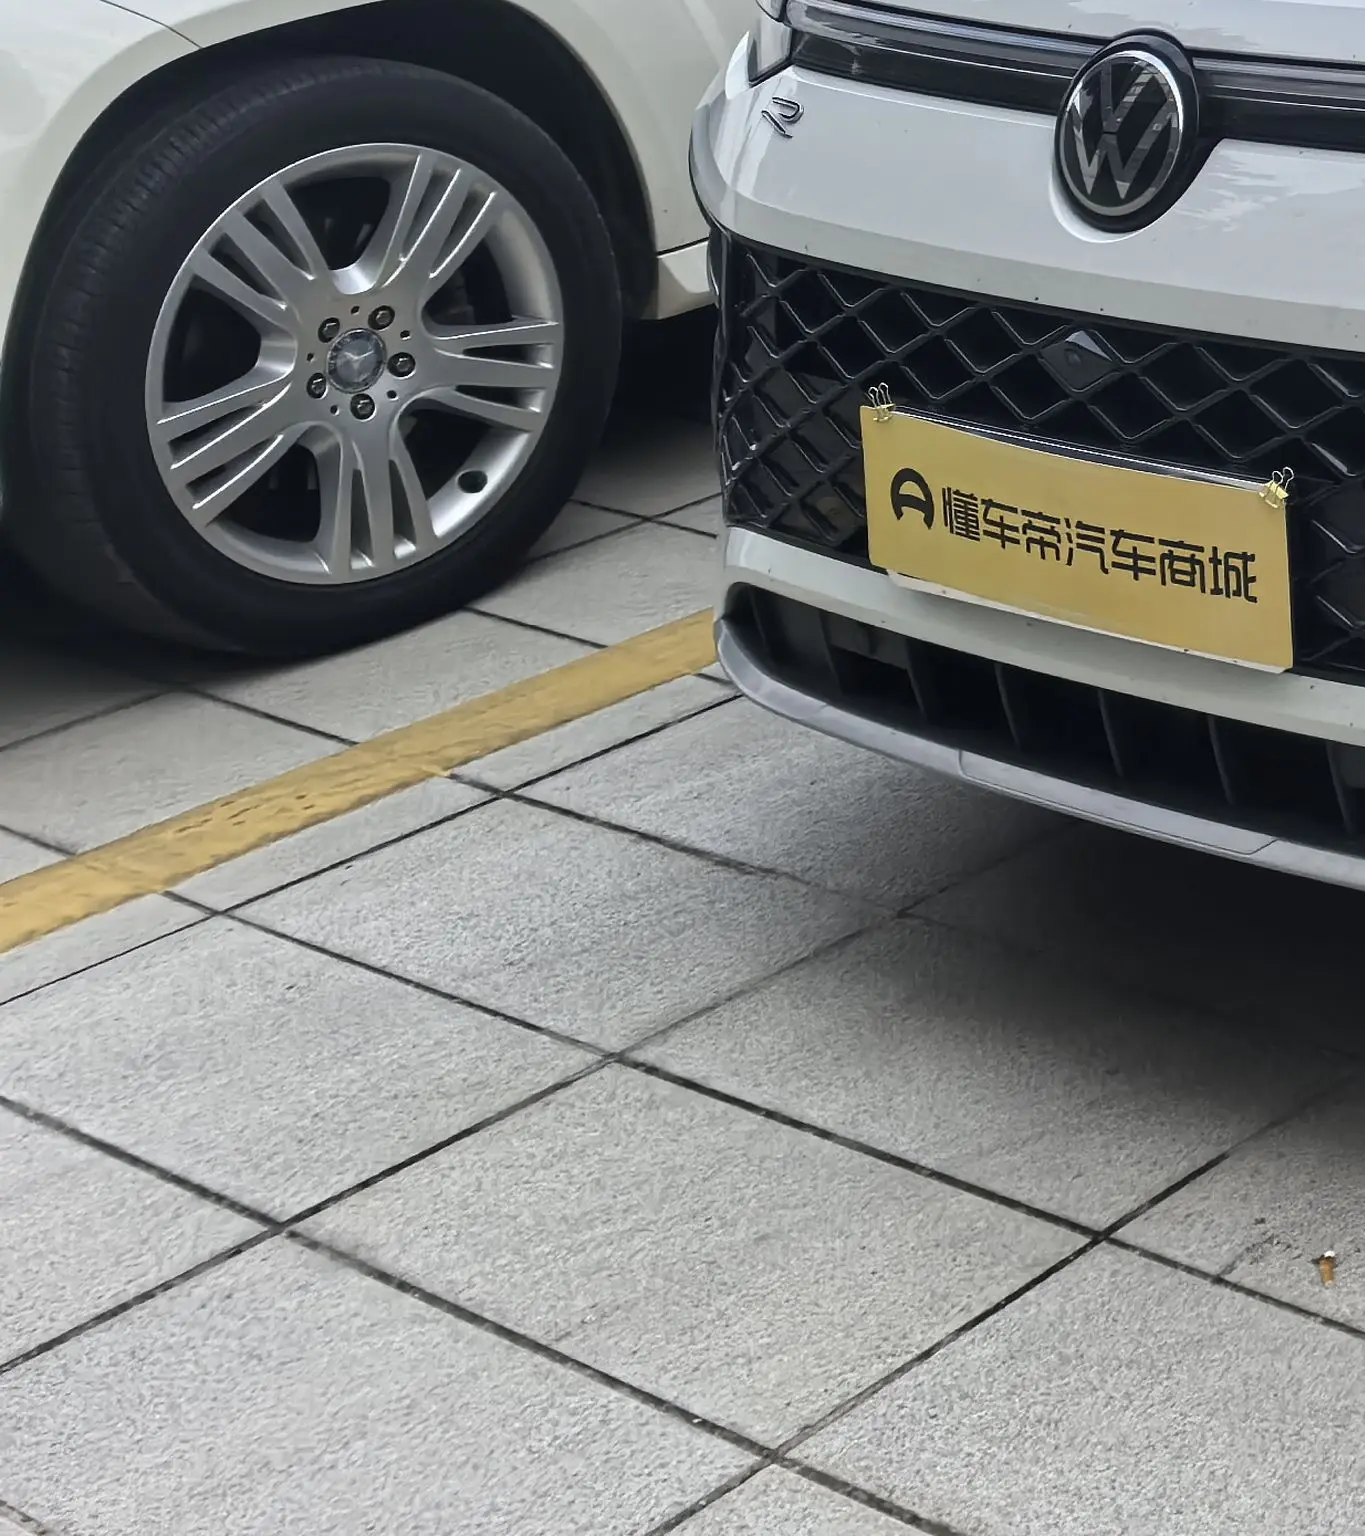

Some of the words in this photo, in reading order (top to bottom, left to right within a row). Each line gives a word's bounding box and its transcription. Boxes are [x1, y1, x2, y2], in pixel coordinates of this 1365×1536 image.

[941, 486, 1259, 604] 懂车帝汽车商城
